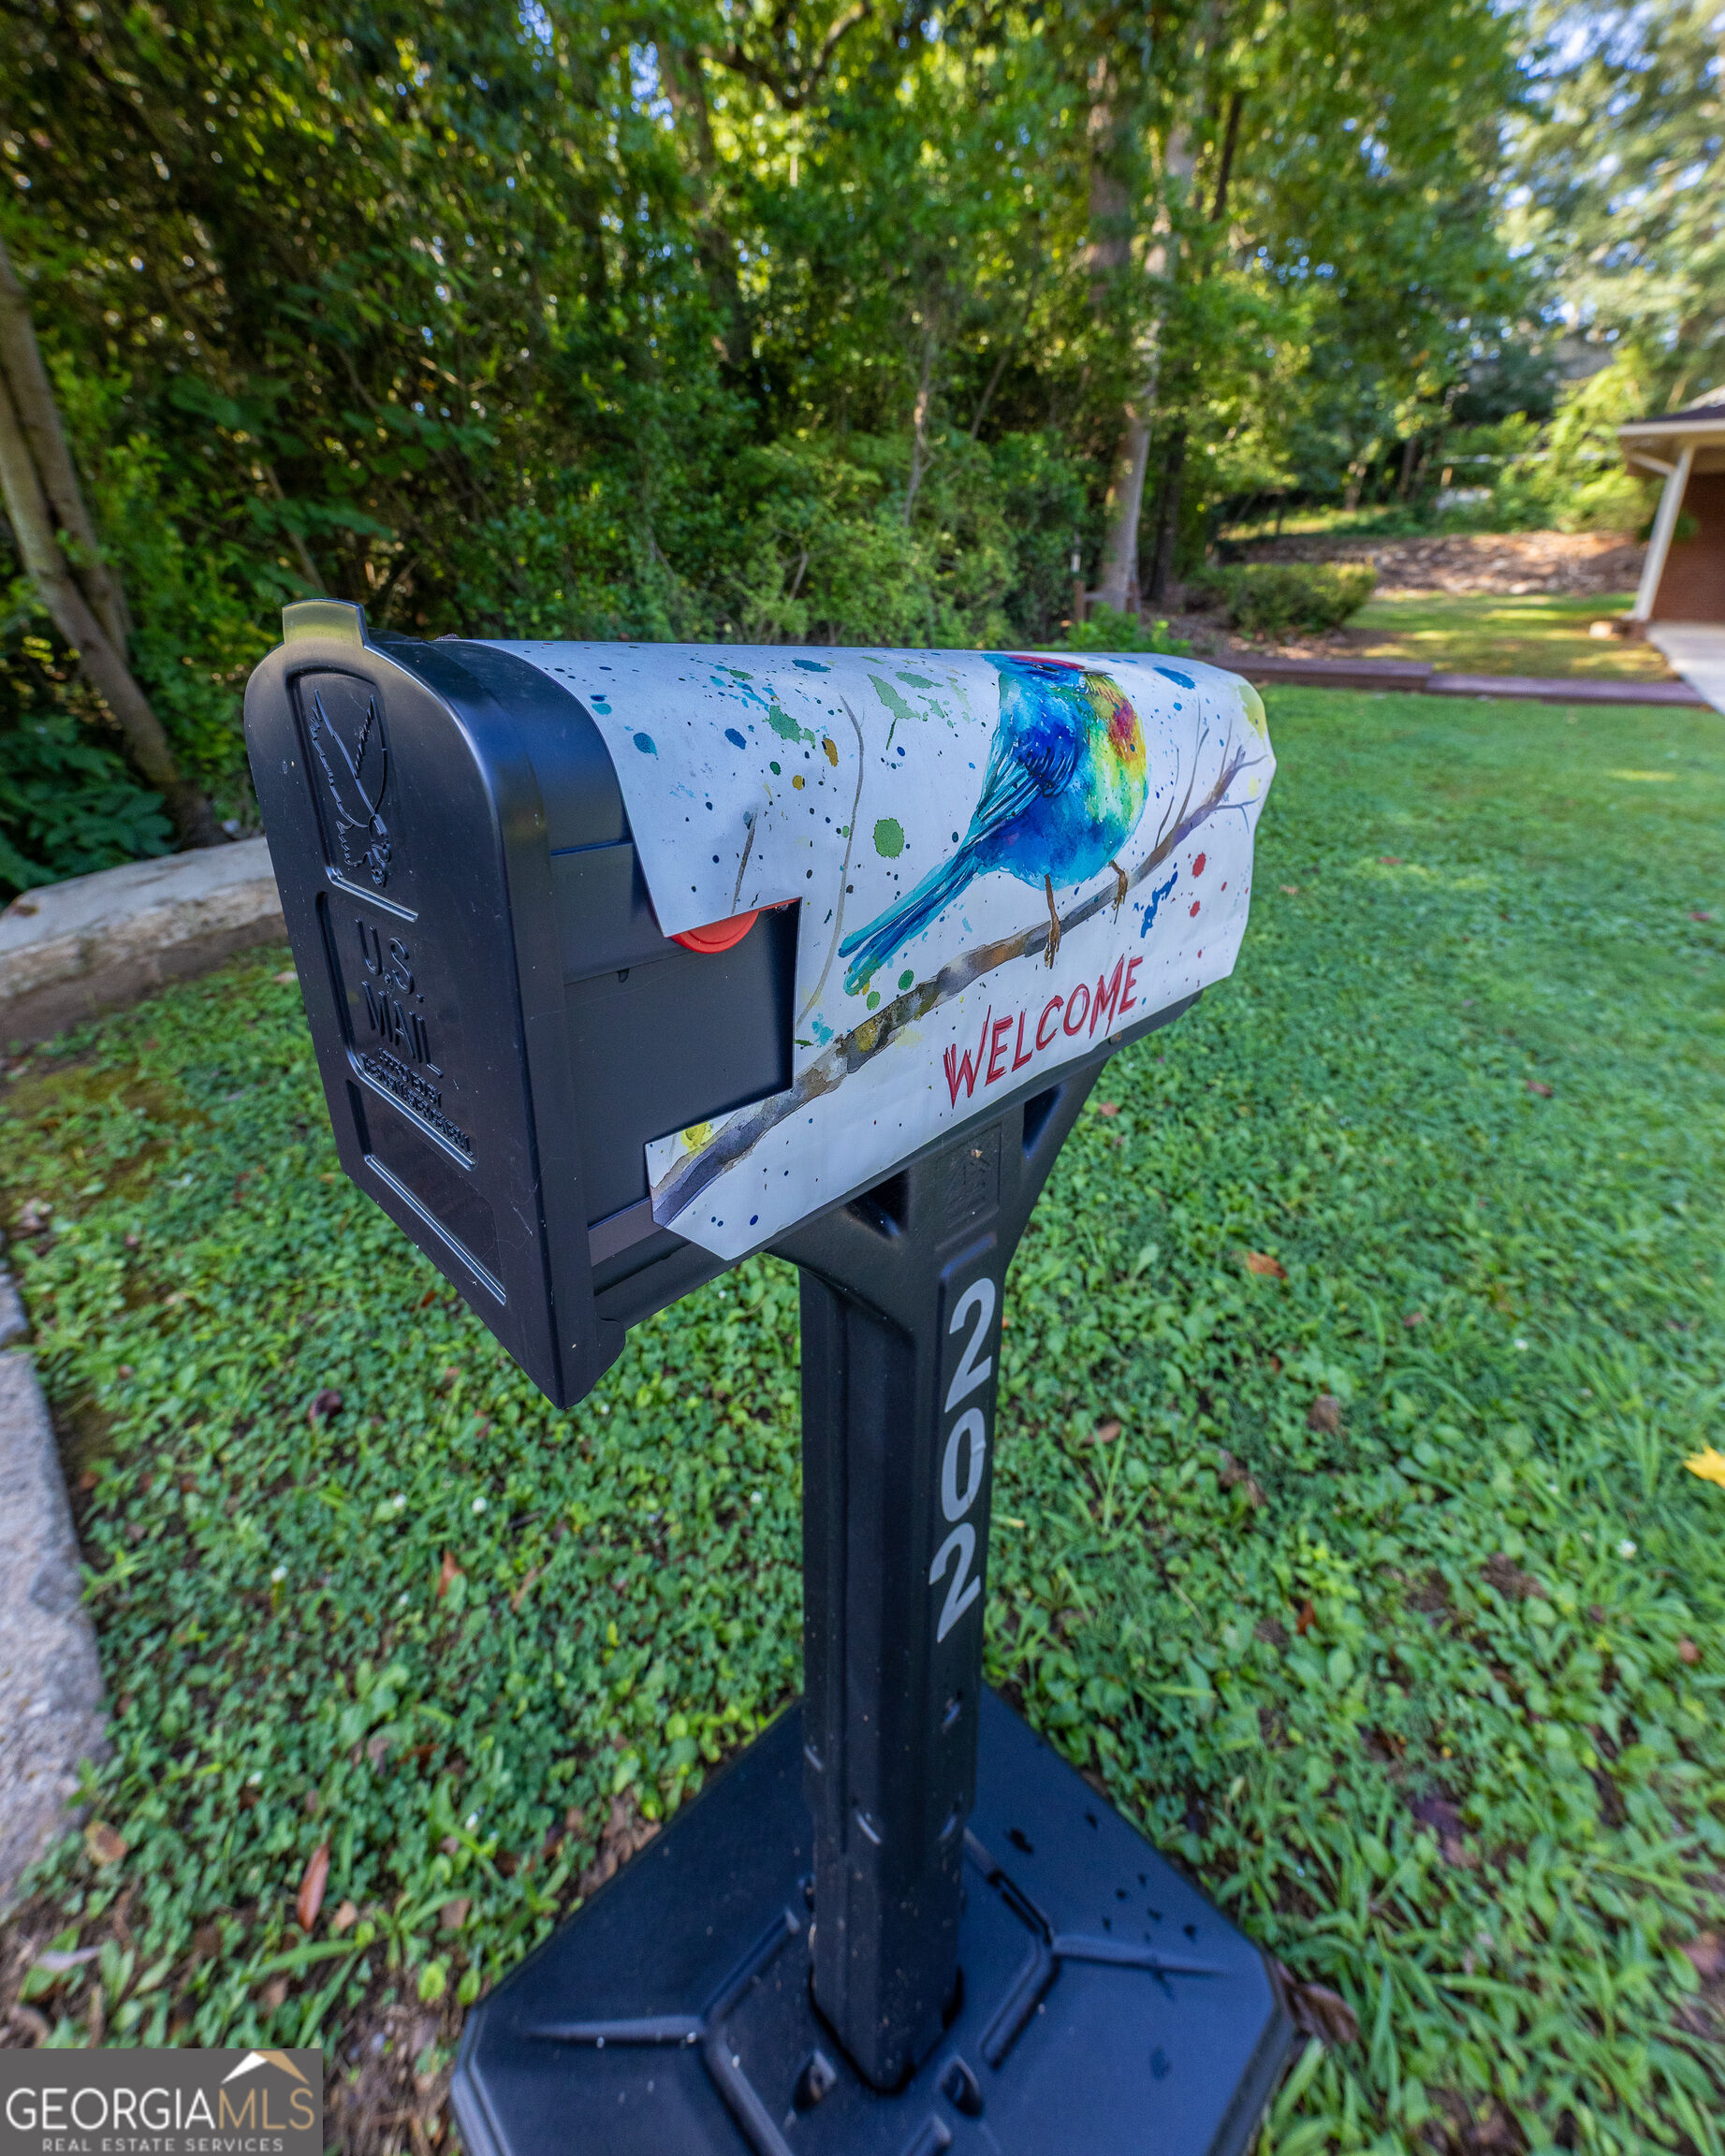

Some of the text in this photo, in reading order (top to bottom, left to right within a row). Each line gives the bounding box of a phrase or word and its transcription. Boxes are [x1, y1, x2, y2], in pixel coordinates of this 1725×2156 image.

[356, 918, 425, 1003] U.S.
[361, 981, 444, 1078] MAIL
[943, 953, 1144, 1109] WELCOME
[928, 1277, 997, 1643] 202
